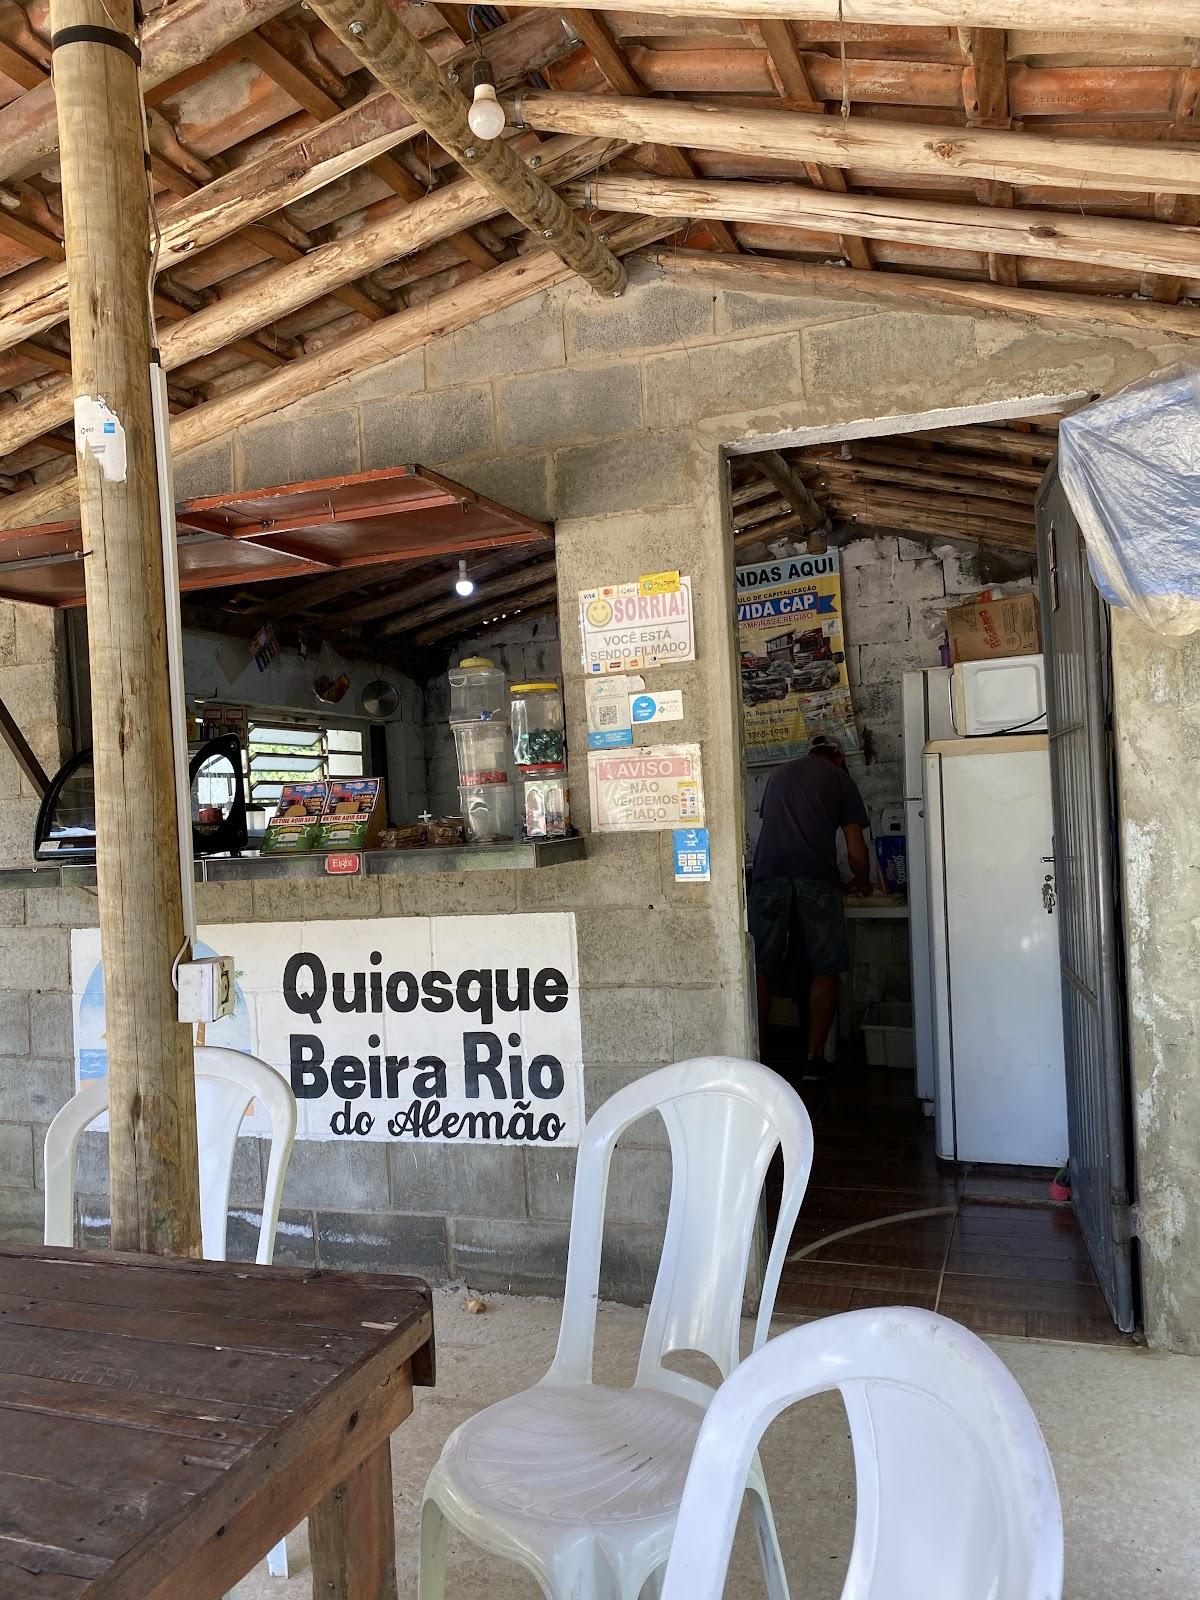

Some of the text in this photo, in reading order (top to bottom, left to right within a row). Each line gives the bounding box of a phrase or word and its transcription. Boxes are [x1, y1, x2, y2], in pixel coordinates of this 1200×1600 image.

[736, 557, 834, 588] NDAS AQUI
[583, 592, 596, 600] VISA
[737, 585, 817, 604] ULO DE CAPITALIZAÇÃO
[613, 591, 685, 623] SORRIA!
[738, 594, 814, 621] VIDA CAP
[783, 612, 813, 622] REGIÃO
[603, 627, 671, 646] VOCÊ ESTÁ
[590, 641, 687, 661] SENDO FILMADO
[616, 760, 674, 778] AVISO
[630, 780, 660, 793] NÃO
[612, 794, 679, 808] VENDEMOS
[625, 807, 668, 820] FIADO
[332, 858, 353, 869] Eight
[282, 950, 569, 1025] Quiosque
[289, 1031, 565, 1100] Beira Rio
[329, 1099, 566, 1142] do Alemão
